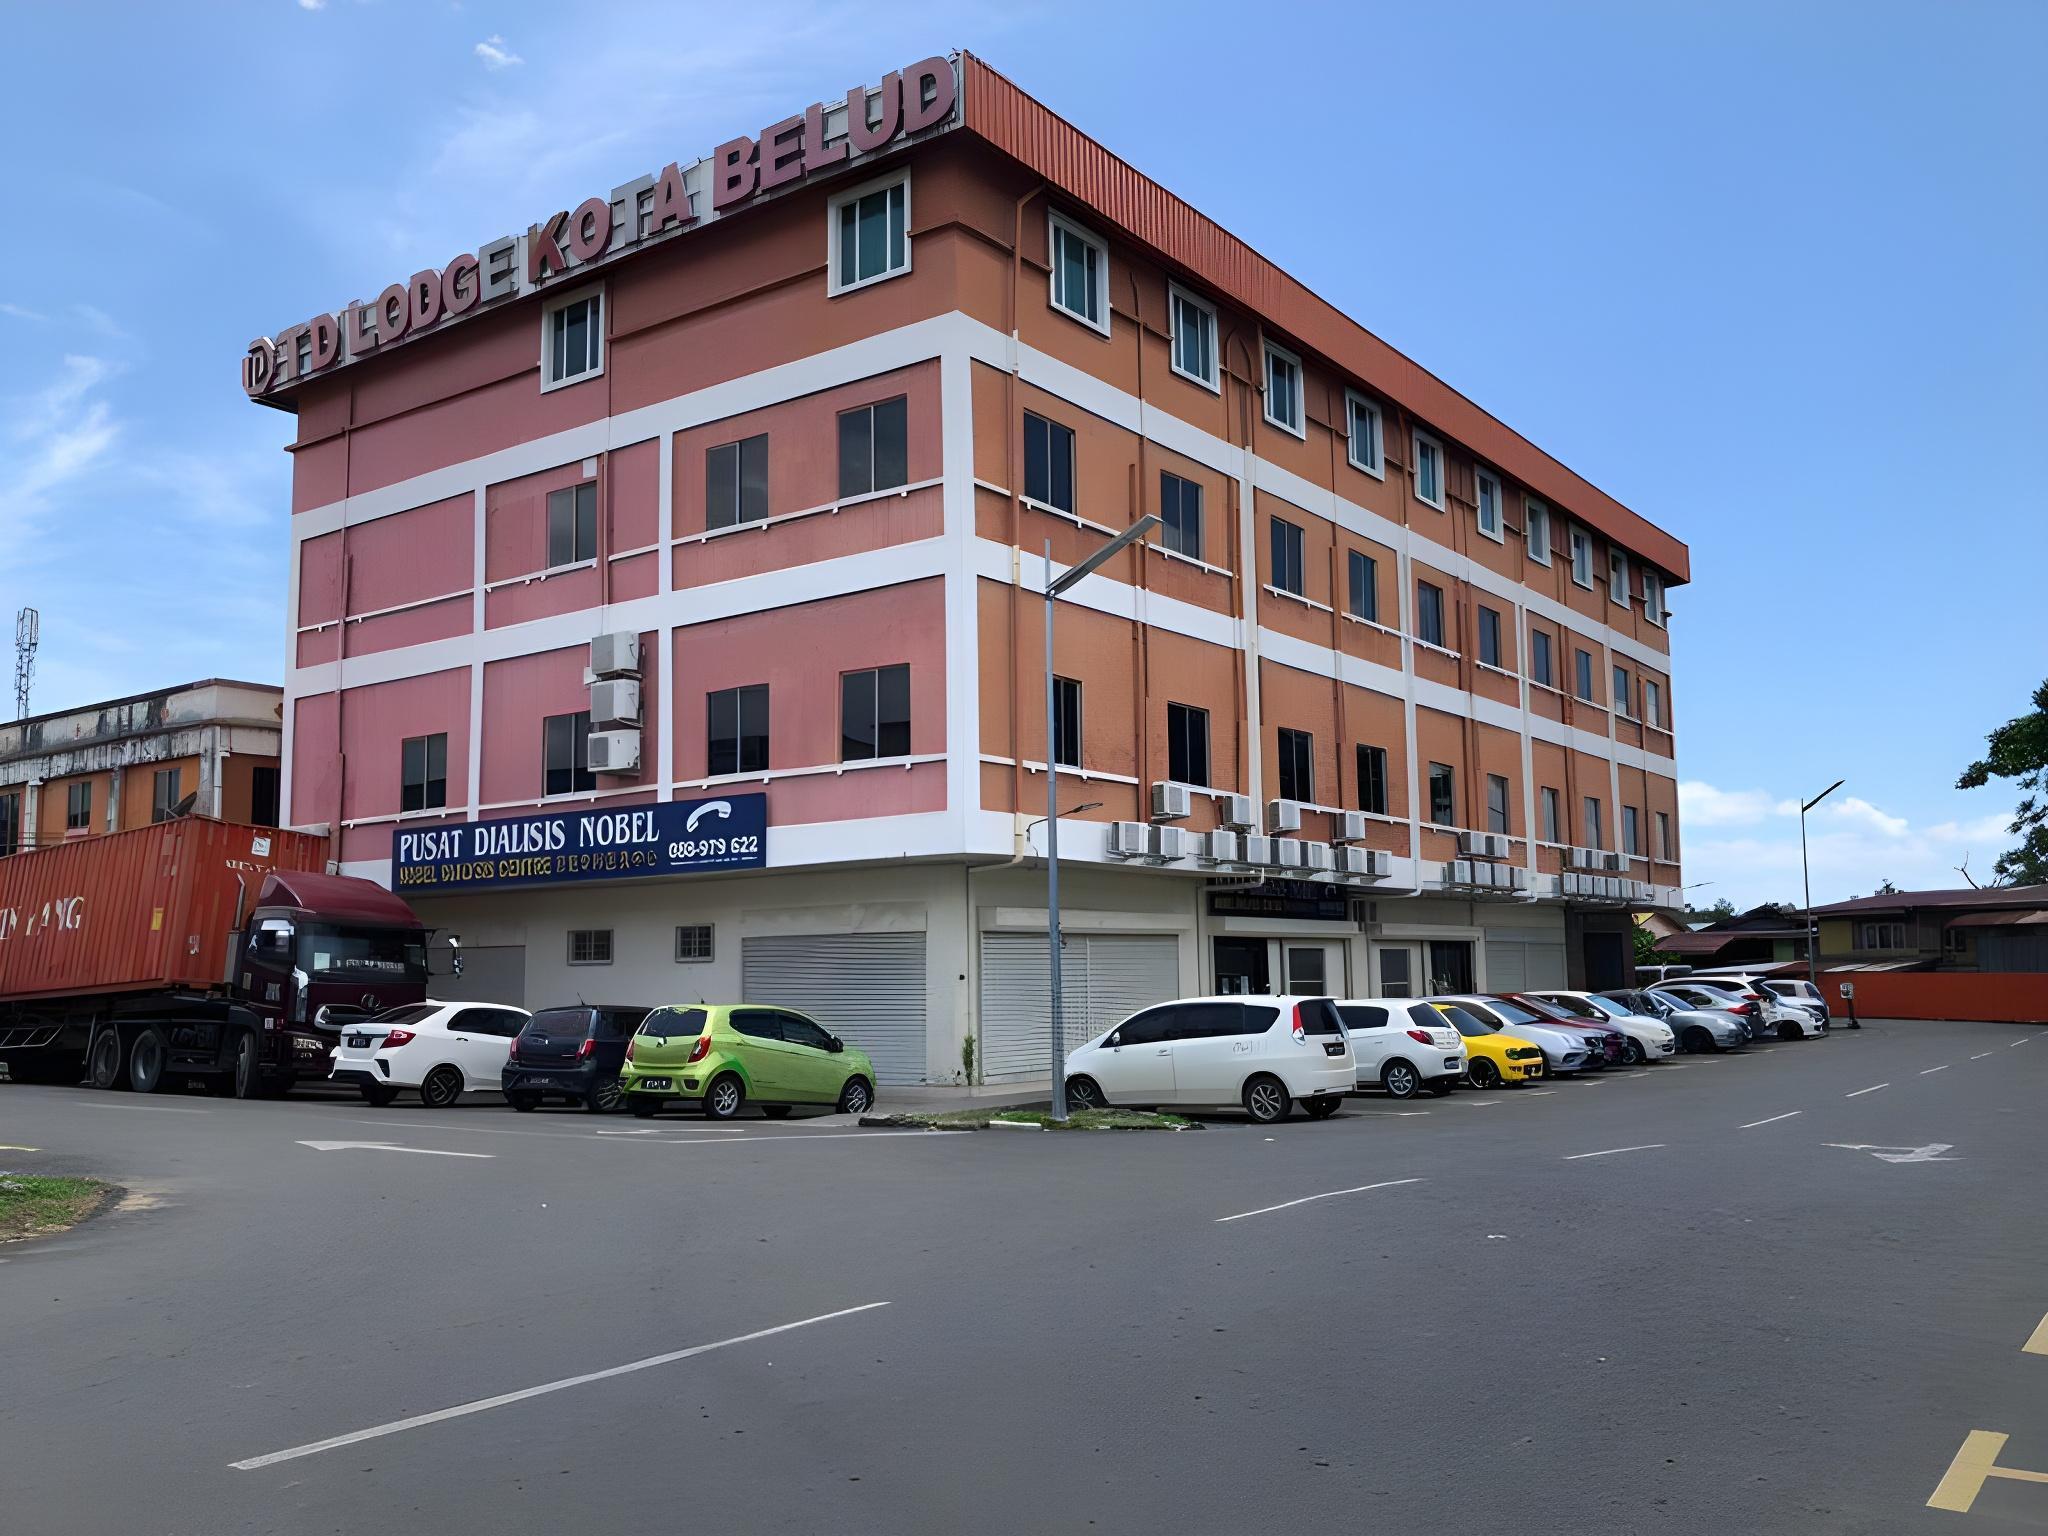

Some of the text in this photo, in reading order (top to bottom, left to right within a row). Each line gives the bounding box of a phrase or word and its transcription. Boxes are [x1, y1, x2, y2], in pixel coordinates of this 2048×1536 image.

[348, 235, 520, 356] LODGE
[528, 161, 697, 283] KOTA
[713, 56, 957, 209] BELUD
[400, 810, 660, 863] PUSAT DIALISIS NOBEL
